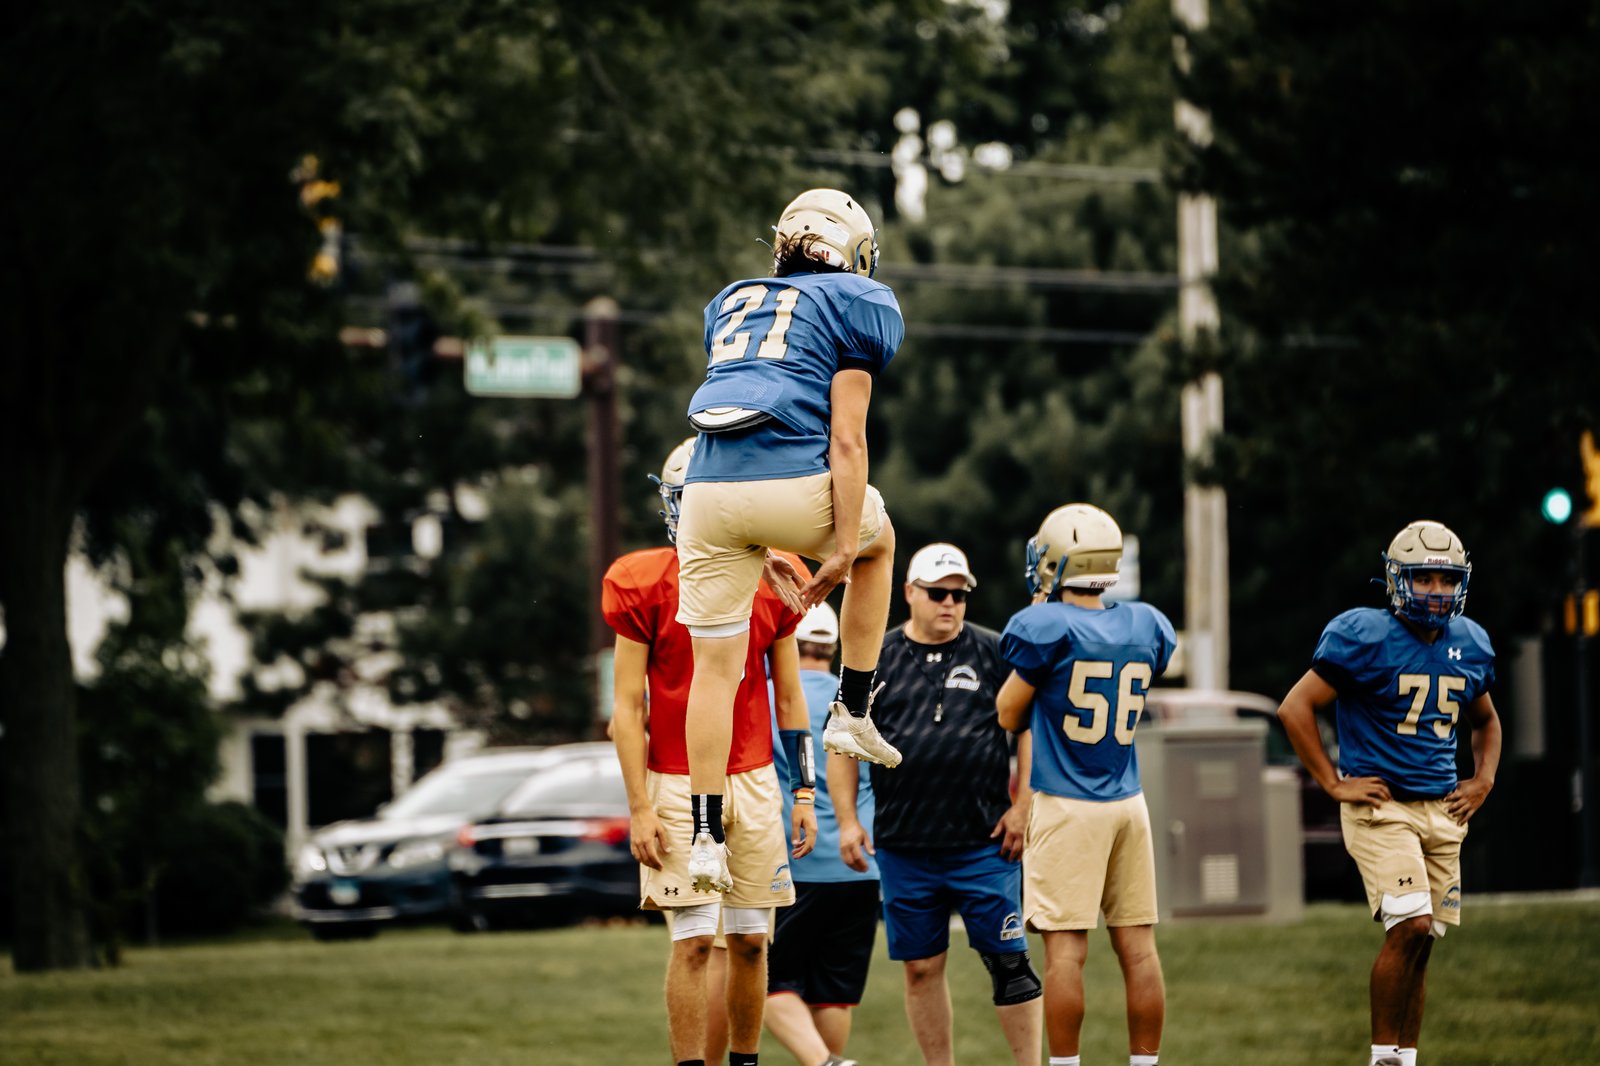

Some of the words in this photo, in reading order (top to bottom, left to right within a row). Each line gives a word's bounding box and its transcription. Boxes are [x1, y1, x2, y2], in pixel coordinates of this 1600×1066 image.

[711, 284, 801, 365] 21
[1062, 660, 1153, 746] 56
[1397, 673, 1466, 739] 75
